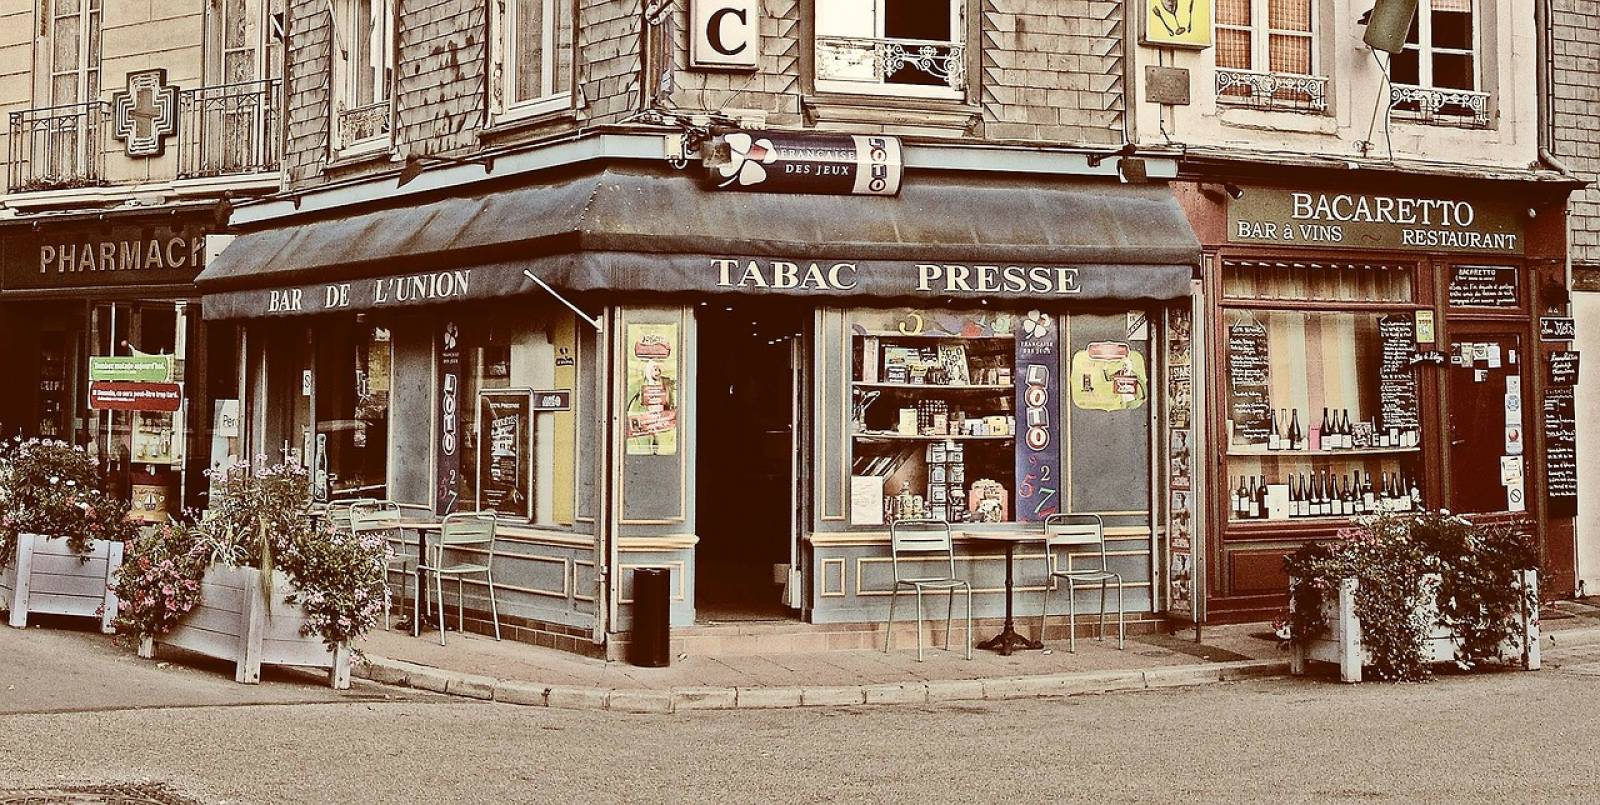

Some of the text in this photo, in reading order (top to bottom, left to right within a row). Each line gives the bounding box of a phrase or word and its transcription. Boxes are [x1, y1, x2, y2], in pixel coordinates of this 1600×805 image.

[706, 7, 747, 56] C
[785, 164, 850, 176] DES JEUX
[1290, 192, 1475, 227] BACARETTO
[1237, 220, 1517, 250] BAR à VINS RESTAURANT
[39, 236, 206, 274] PHARMACI
[268, 269, 472, 312] BAR DE L'UNION
[710, 258, 1082, 294] TABAC PRESSE
[1025, 364, 1050, 450] LOTO
[1040, 465, 1050, 481] 2
[1034, 487, 1056, 513] 7
